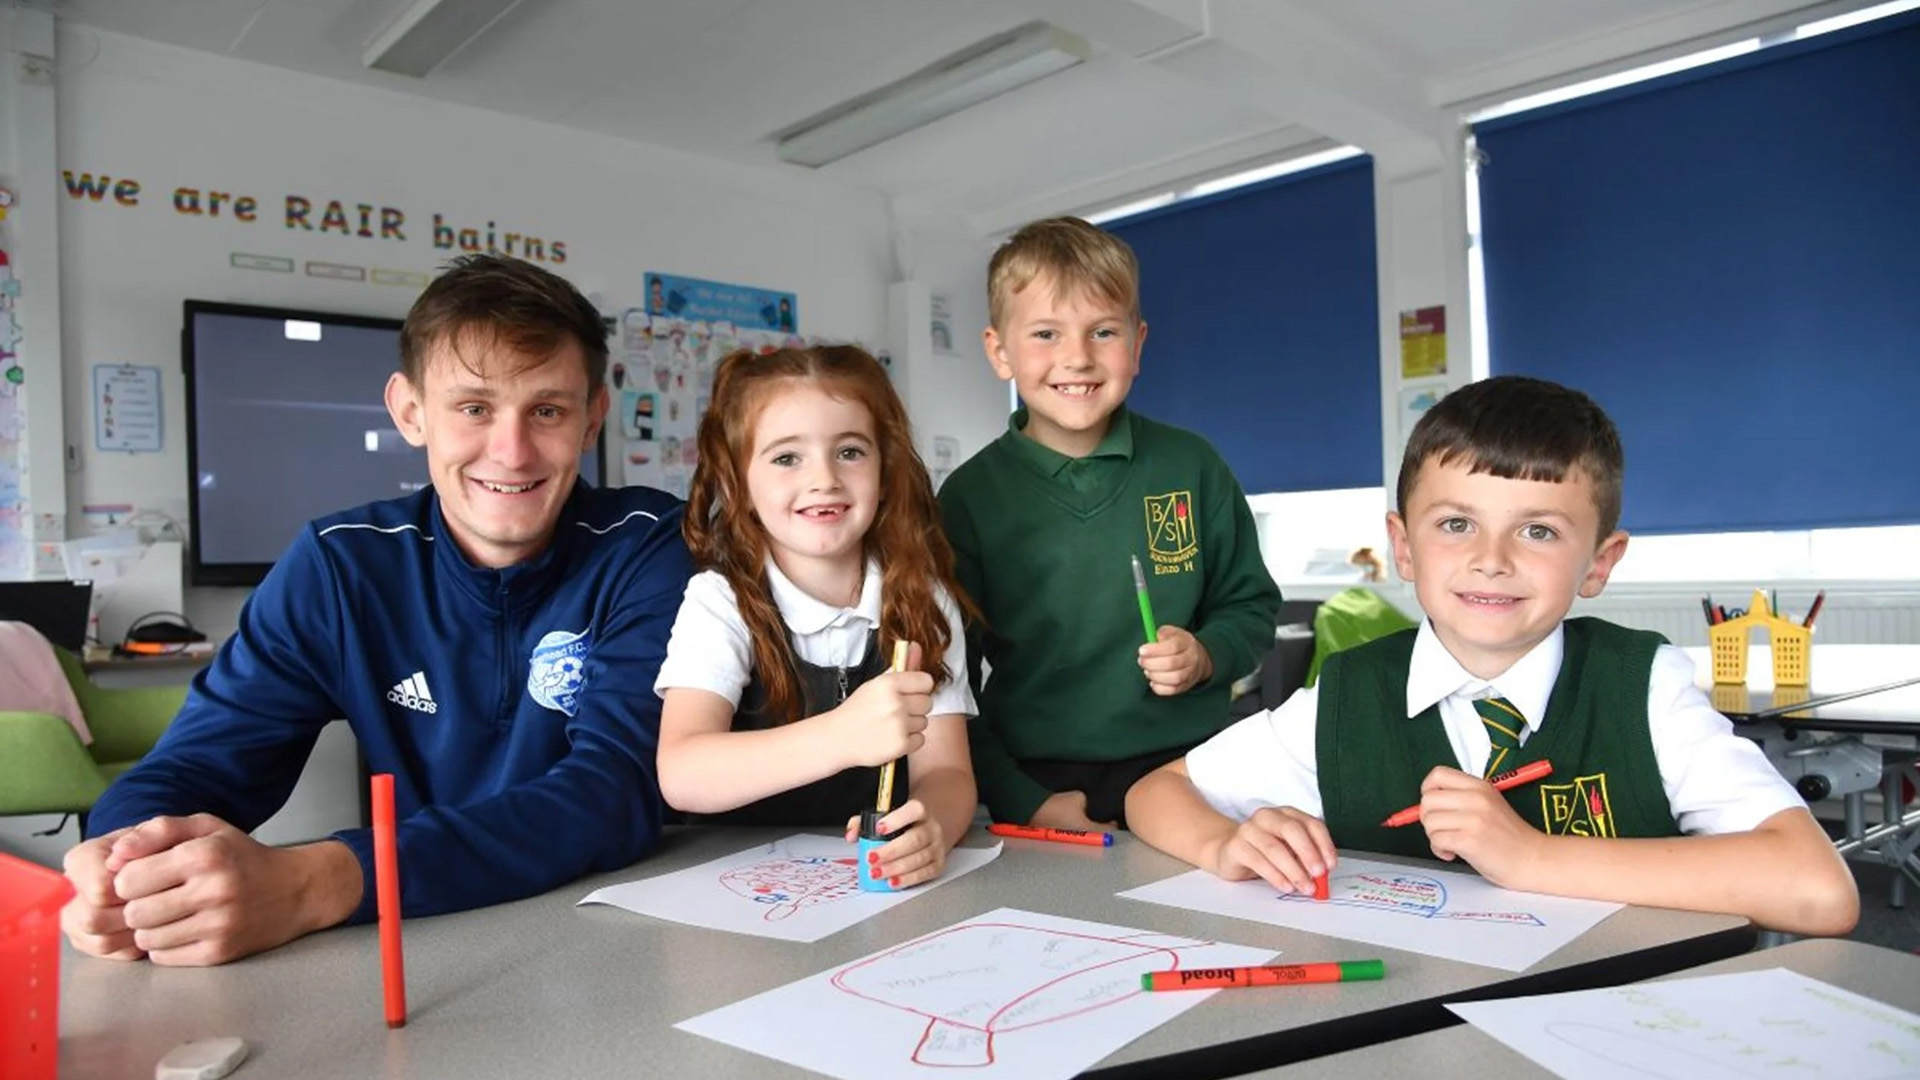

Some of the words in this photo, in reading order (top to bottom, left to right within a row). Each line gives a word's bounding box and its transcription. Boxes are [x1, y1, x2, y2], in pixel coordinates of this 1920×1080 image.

[63, 170, 140, 207] we
[173, 187, 257, 222] are
[284, 195, 406, 241] RAIR
[432, 213, 567, 264] bairns
[1152, 503, 1163, 522] B
[1164, 522, 1176, 541] S
[1155, 564, 1180, 575] Enzo
[1183, 560, 1194, 572] H
[386, 690, 438, 714] adidas
[1552, 794, 1569, 822] B
[1181, 967, 1236, 985] broad
